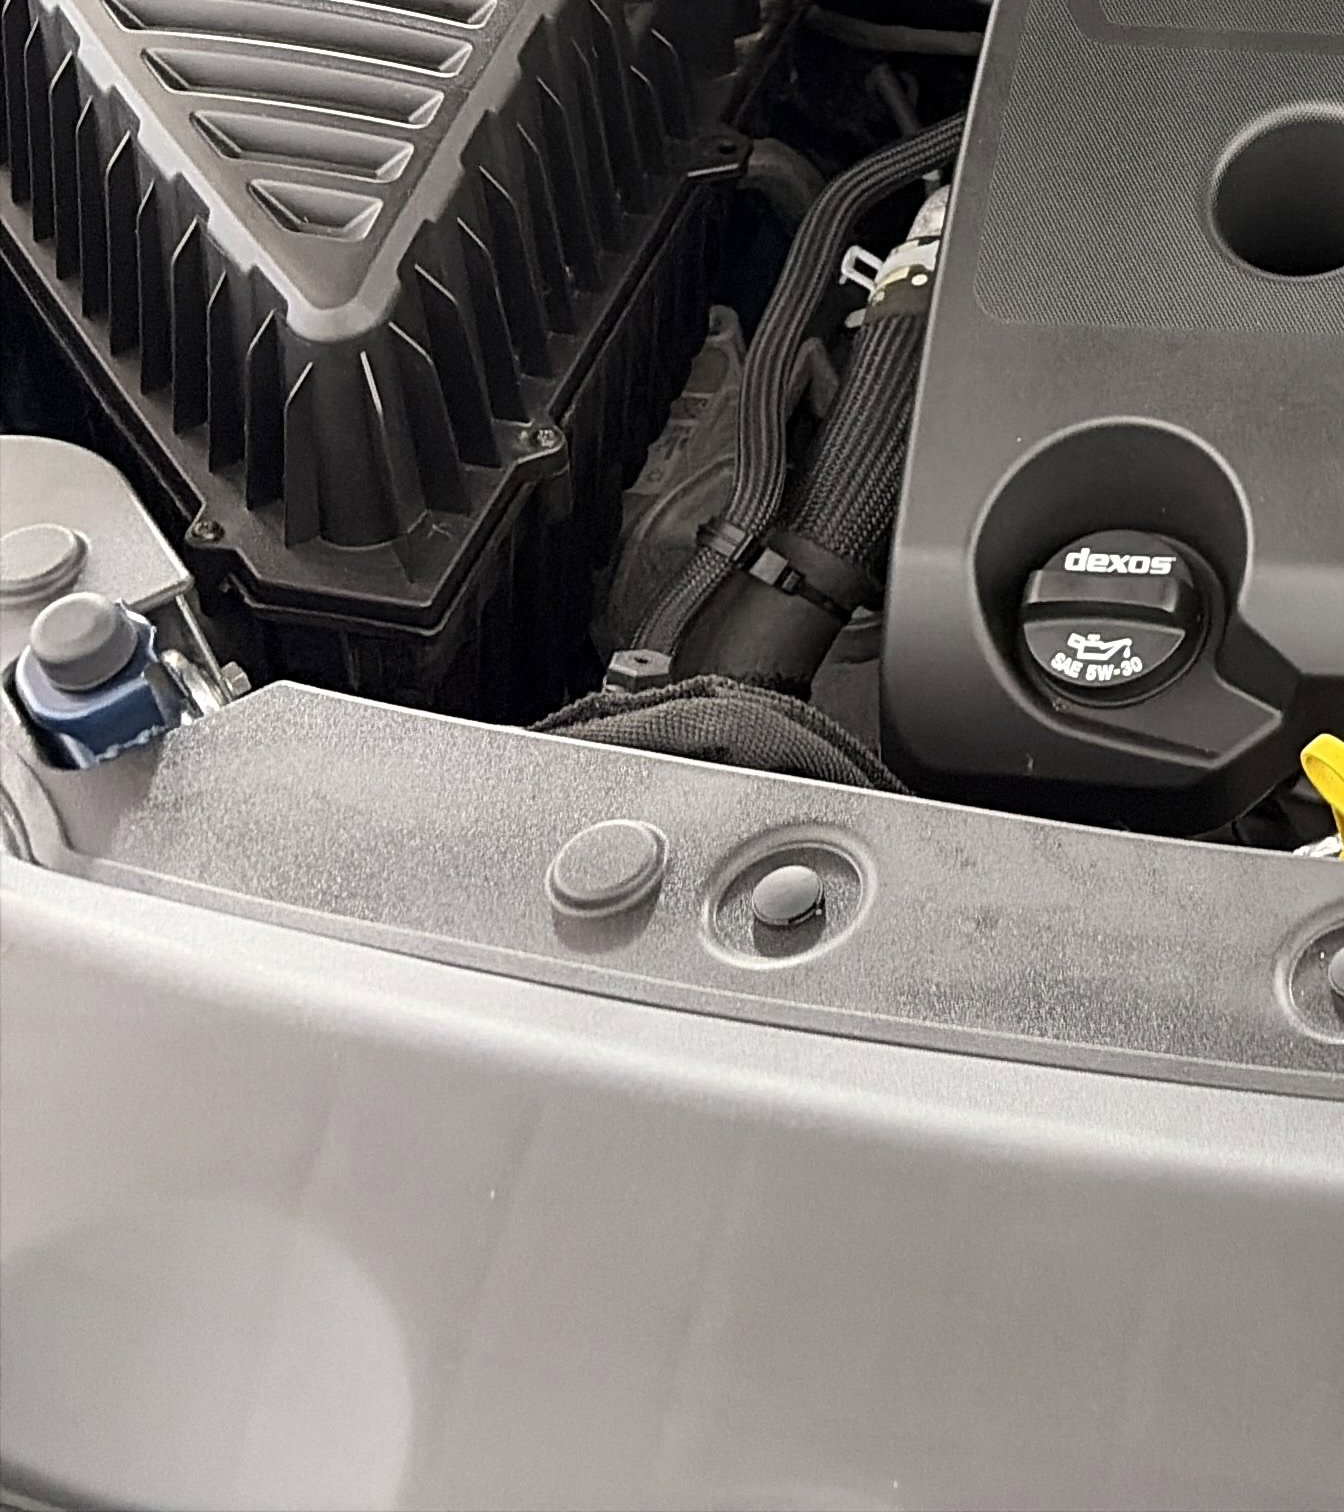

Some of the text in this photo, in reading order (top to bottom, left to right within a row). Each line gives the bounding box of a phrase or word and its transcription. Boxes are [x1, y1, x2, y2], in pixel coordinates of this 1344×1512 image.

[1064, 547, 1173, 576] dexos
[1050, 652, 1143, 682] SAE 5W-30
